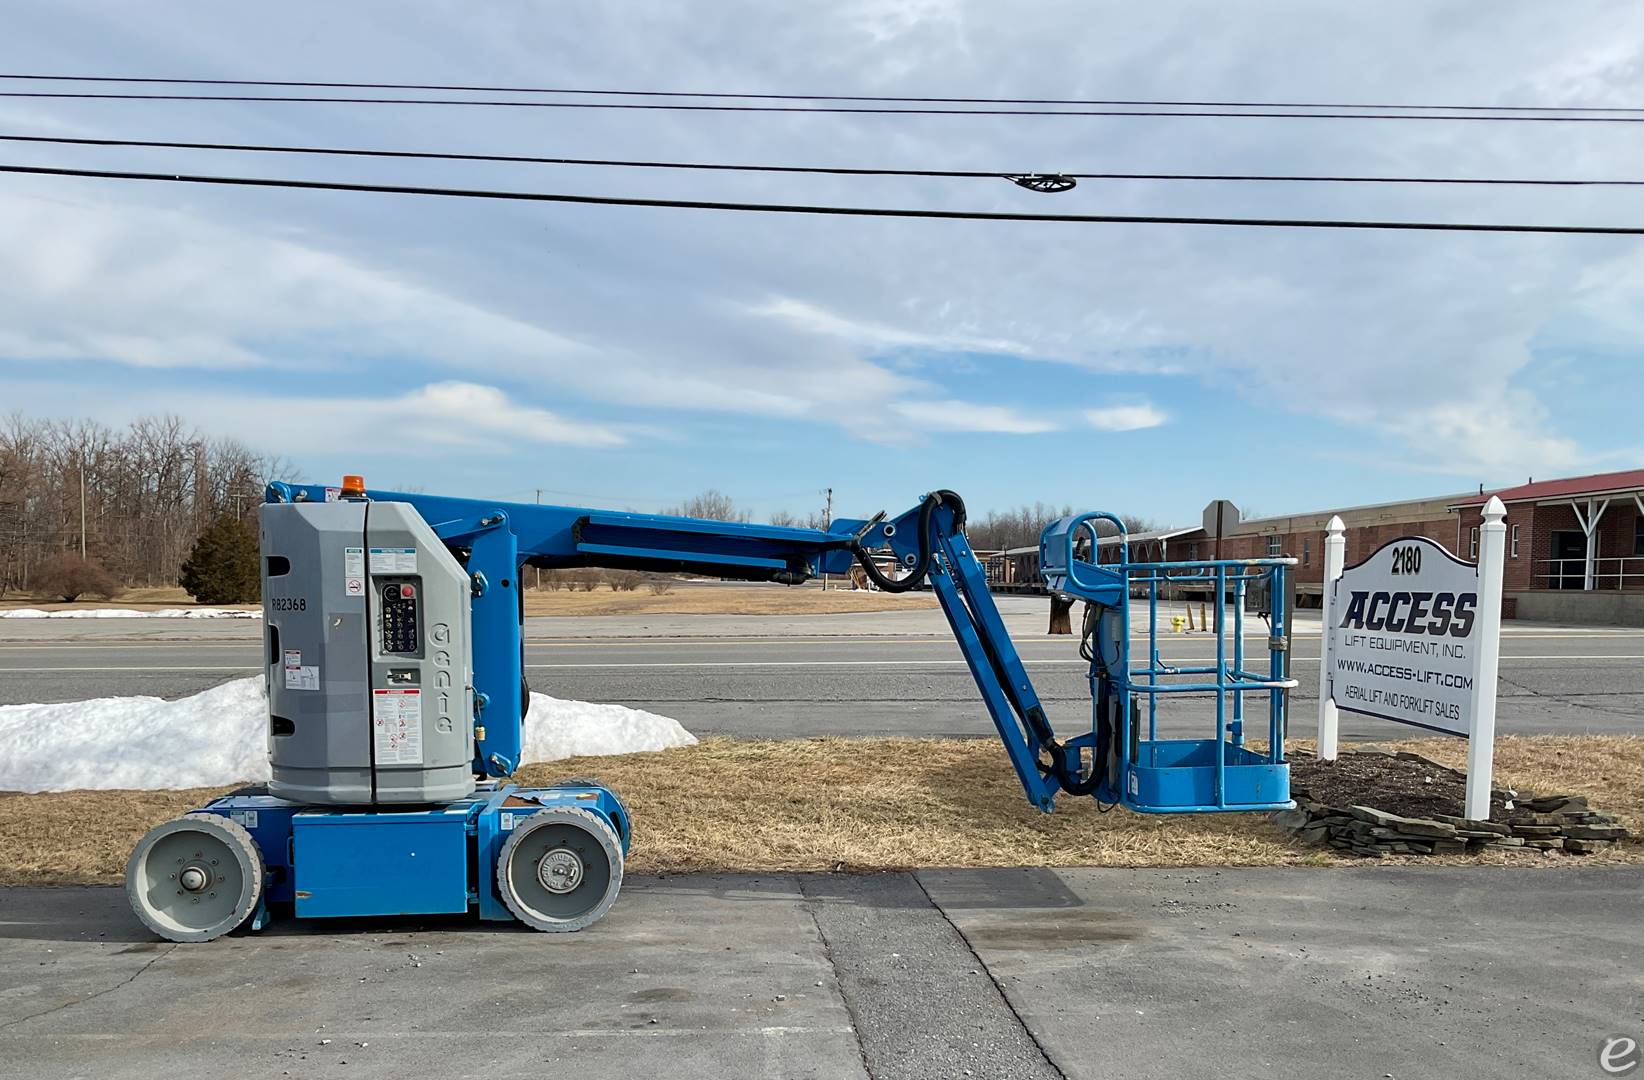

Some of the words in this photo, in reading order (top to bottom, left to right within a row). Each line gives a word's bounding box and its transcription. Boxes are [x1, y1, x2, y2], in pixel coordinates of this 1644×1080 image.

[1391, 546, 1422, 575] 2180
[1339, 591, 1477, 638] ACCESS
[1345, 635, 1366, 647] LIFT
[1369, 637, 1439, 657] EQUIPMENT,
[1443, 644, 1466, 659] INC.
[1337, 659, 1473, 691] WWW.ACCESS-LIFT.COM
[1345, 685, 1367, 702] AERIAL
[1369, 689, 1383, 703] LIFT
[1383, 691, 1398, 707] AND
[1400, 694, 1434, 714] FORKLIFT
[1435, 701, 1460, 720] SALES
